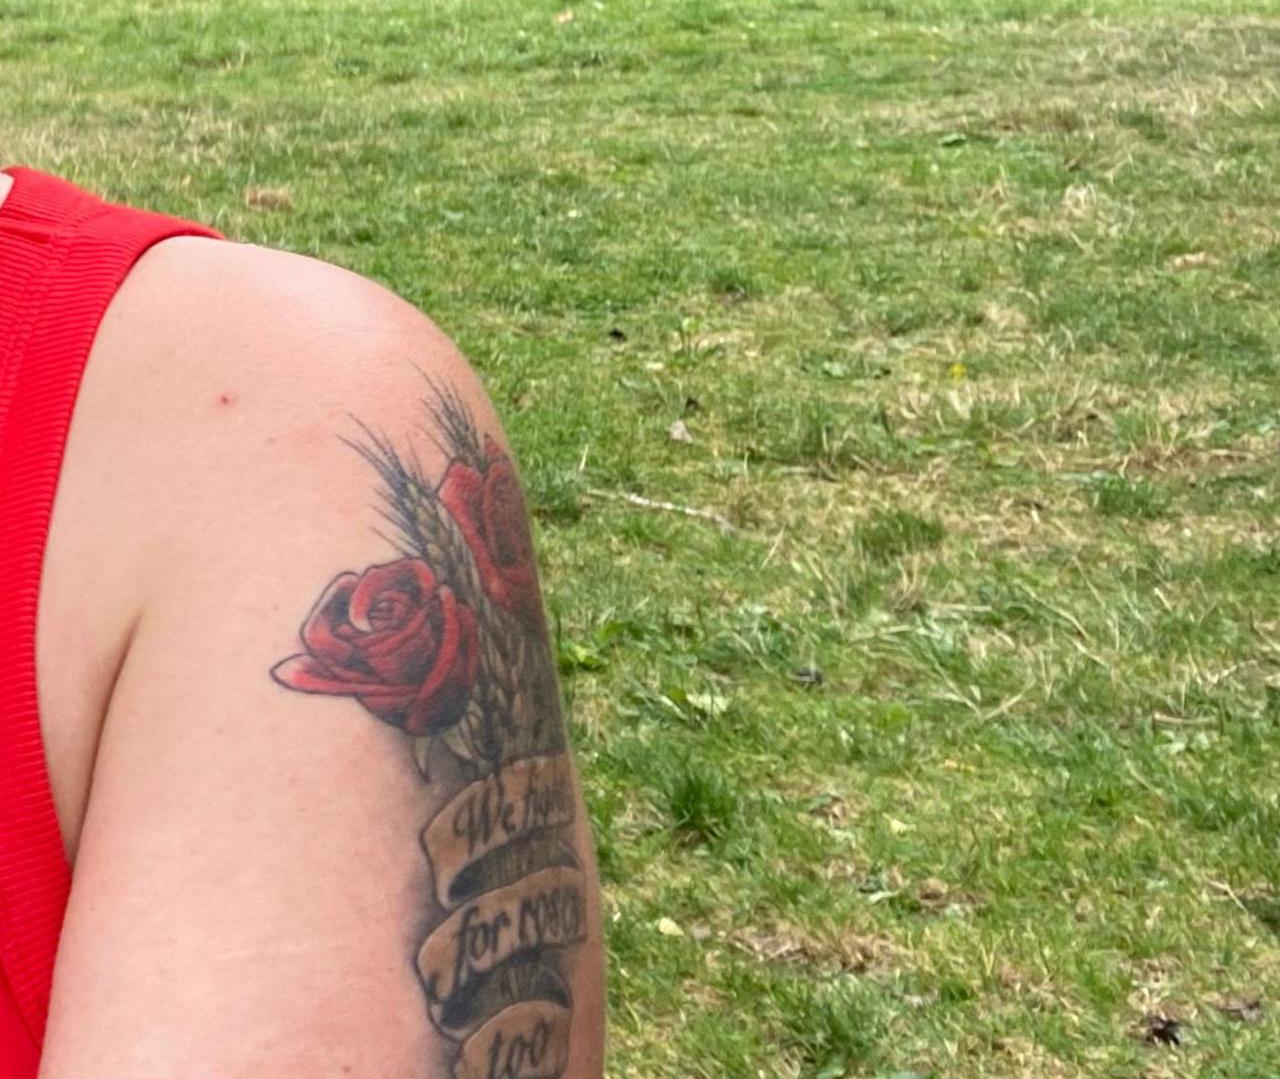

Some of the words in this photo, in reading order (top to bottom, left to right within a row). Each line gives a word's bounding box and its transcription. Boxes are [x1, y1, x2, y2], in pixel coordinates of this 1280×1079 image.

[451, 770, 517, 854] We
[429, 905, 511, 1003] for
[486, 1020, 550, 1078] too
